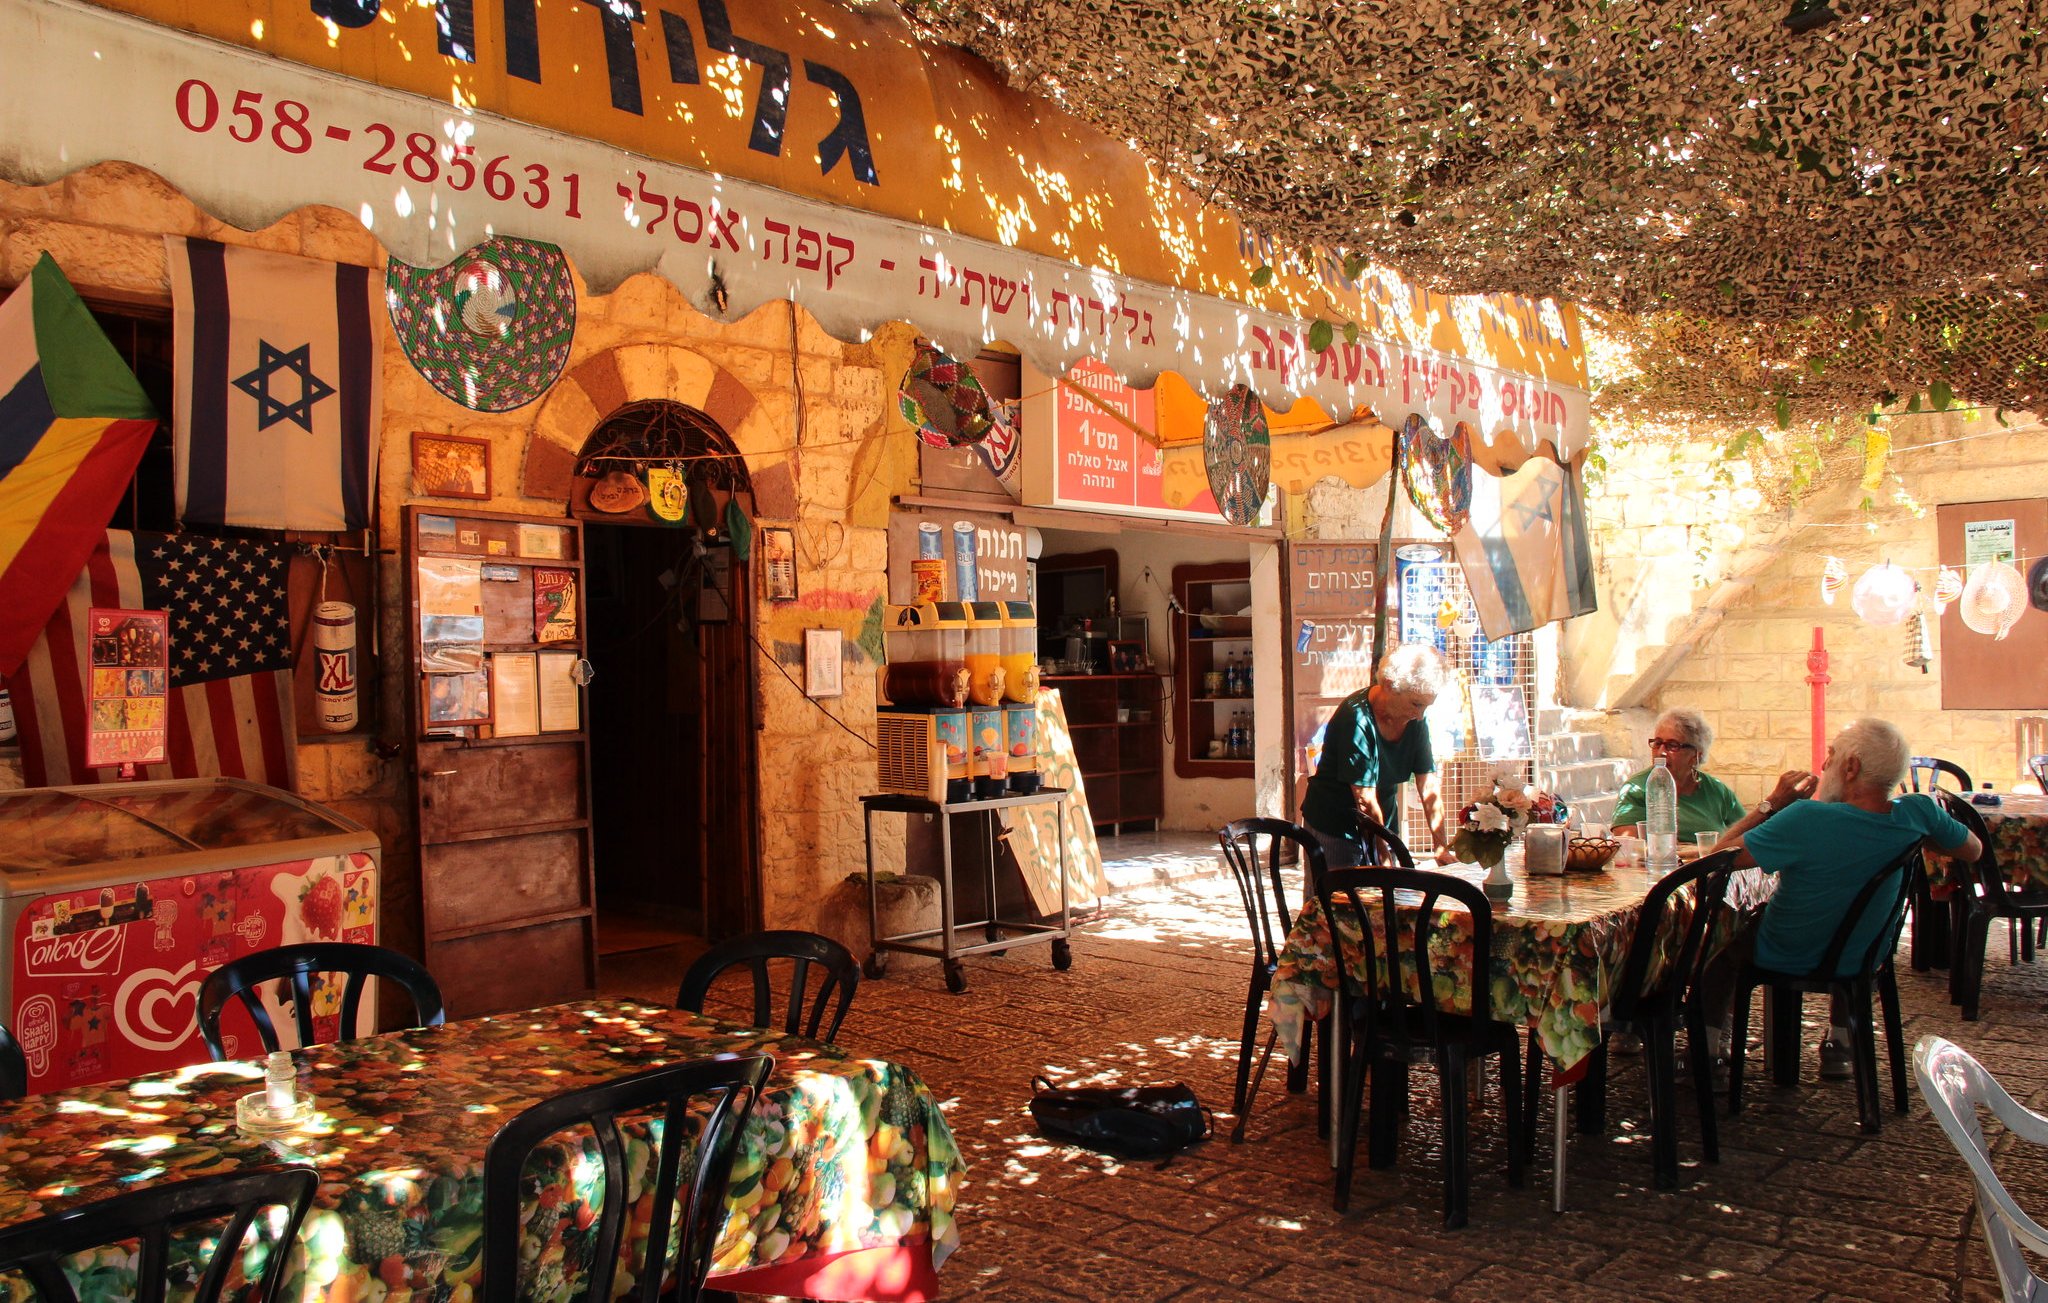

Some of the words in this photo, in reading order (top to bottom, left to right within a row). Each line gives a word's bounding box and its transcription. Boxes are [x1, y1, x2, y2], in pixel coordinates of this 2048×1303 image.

[175, 79, 582, 219] 058-285631
[616, 171, 740, 254] אסלי
[763, 217, 856, 291] קפה
[918, 254, 1031, 321] ושתיה
[1050, 288, 1156, 348] גלידות
[1070, 368, 1124, 393] החומוס
[1500, 382, 1568, 428] חומוס
[1068, 450, 1101, 469] סאלח
[1105, 455, 1128, 472] אצל
[1083, 473, 1115, 489] ונזהה
[977, 527, 1023, 560] חנות
[1308, 571, 1374, 589] פצוחים
[321, 653, 355, 690] XL
